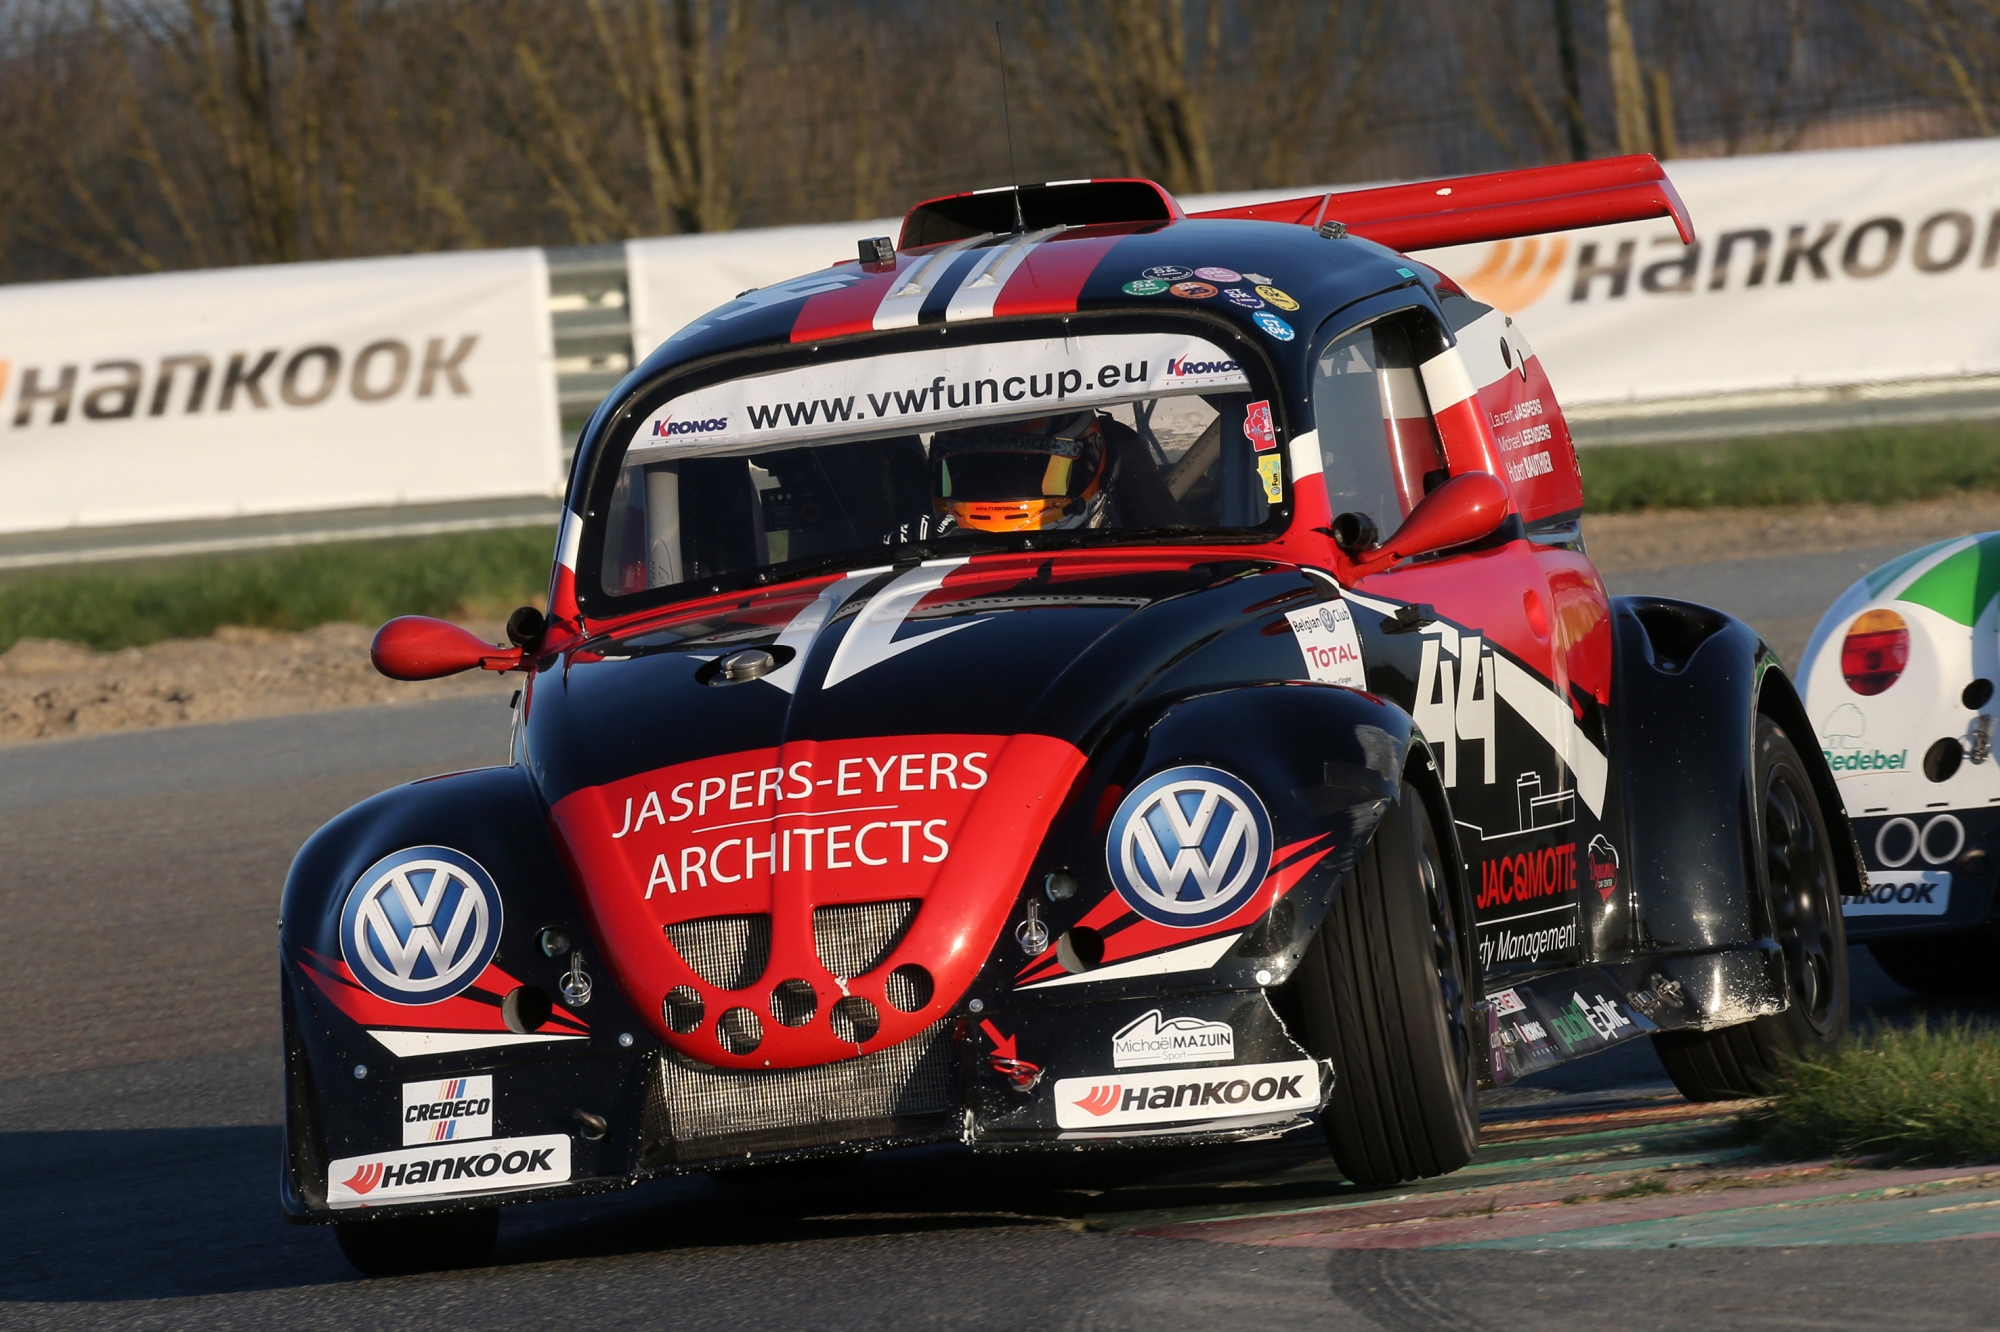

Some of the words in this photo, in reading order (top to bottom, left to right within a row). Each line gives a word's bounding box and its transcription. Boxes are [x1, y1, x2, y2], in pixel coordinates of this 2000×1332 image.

[1167, 353, 1242, 376] KRONOS
[747, 360, 1148, 429] www.vwfuncup.eu
[1513, 398, 1543, 421] JASPERS
[652, 413, 729, 437] KRONOS
[1521, 423, 1552, 447] LEENDERS
[1292, 616, 1322, 633] Belgian
[1332, 607, 1350, 622] Club
[1306, 643, 1358, 669] TOTAL
[1413, 636, 1496, 787] 44
[612, 752, 989, 838] JASPERS-EYERS
[644, 818, 950, 899] ARCHITECTS
[1477, 842, 1577, 909] JACQMOTTE
[1496, 917, 1577, 963] Management
[1172, 1032, 1231, 1049] MAZUIN
[1162, 1051, 1186, 1062] Sport
[405, 1098, 490, 1123] CREDECO
